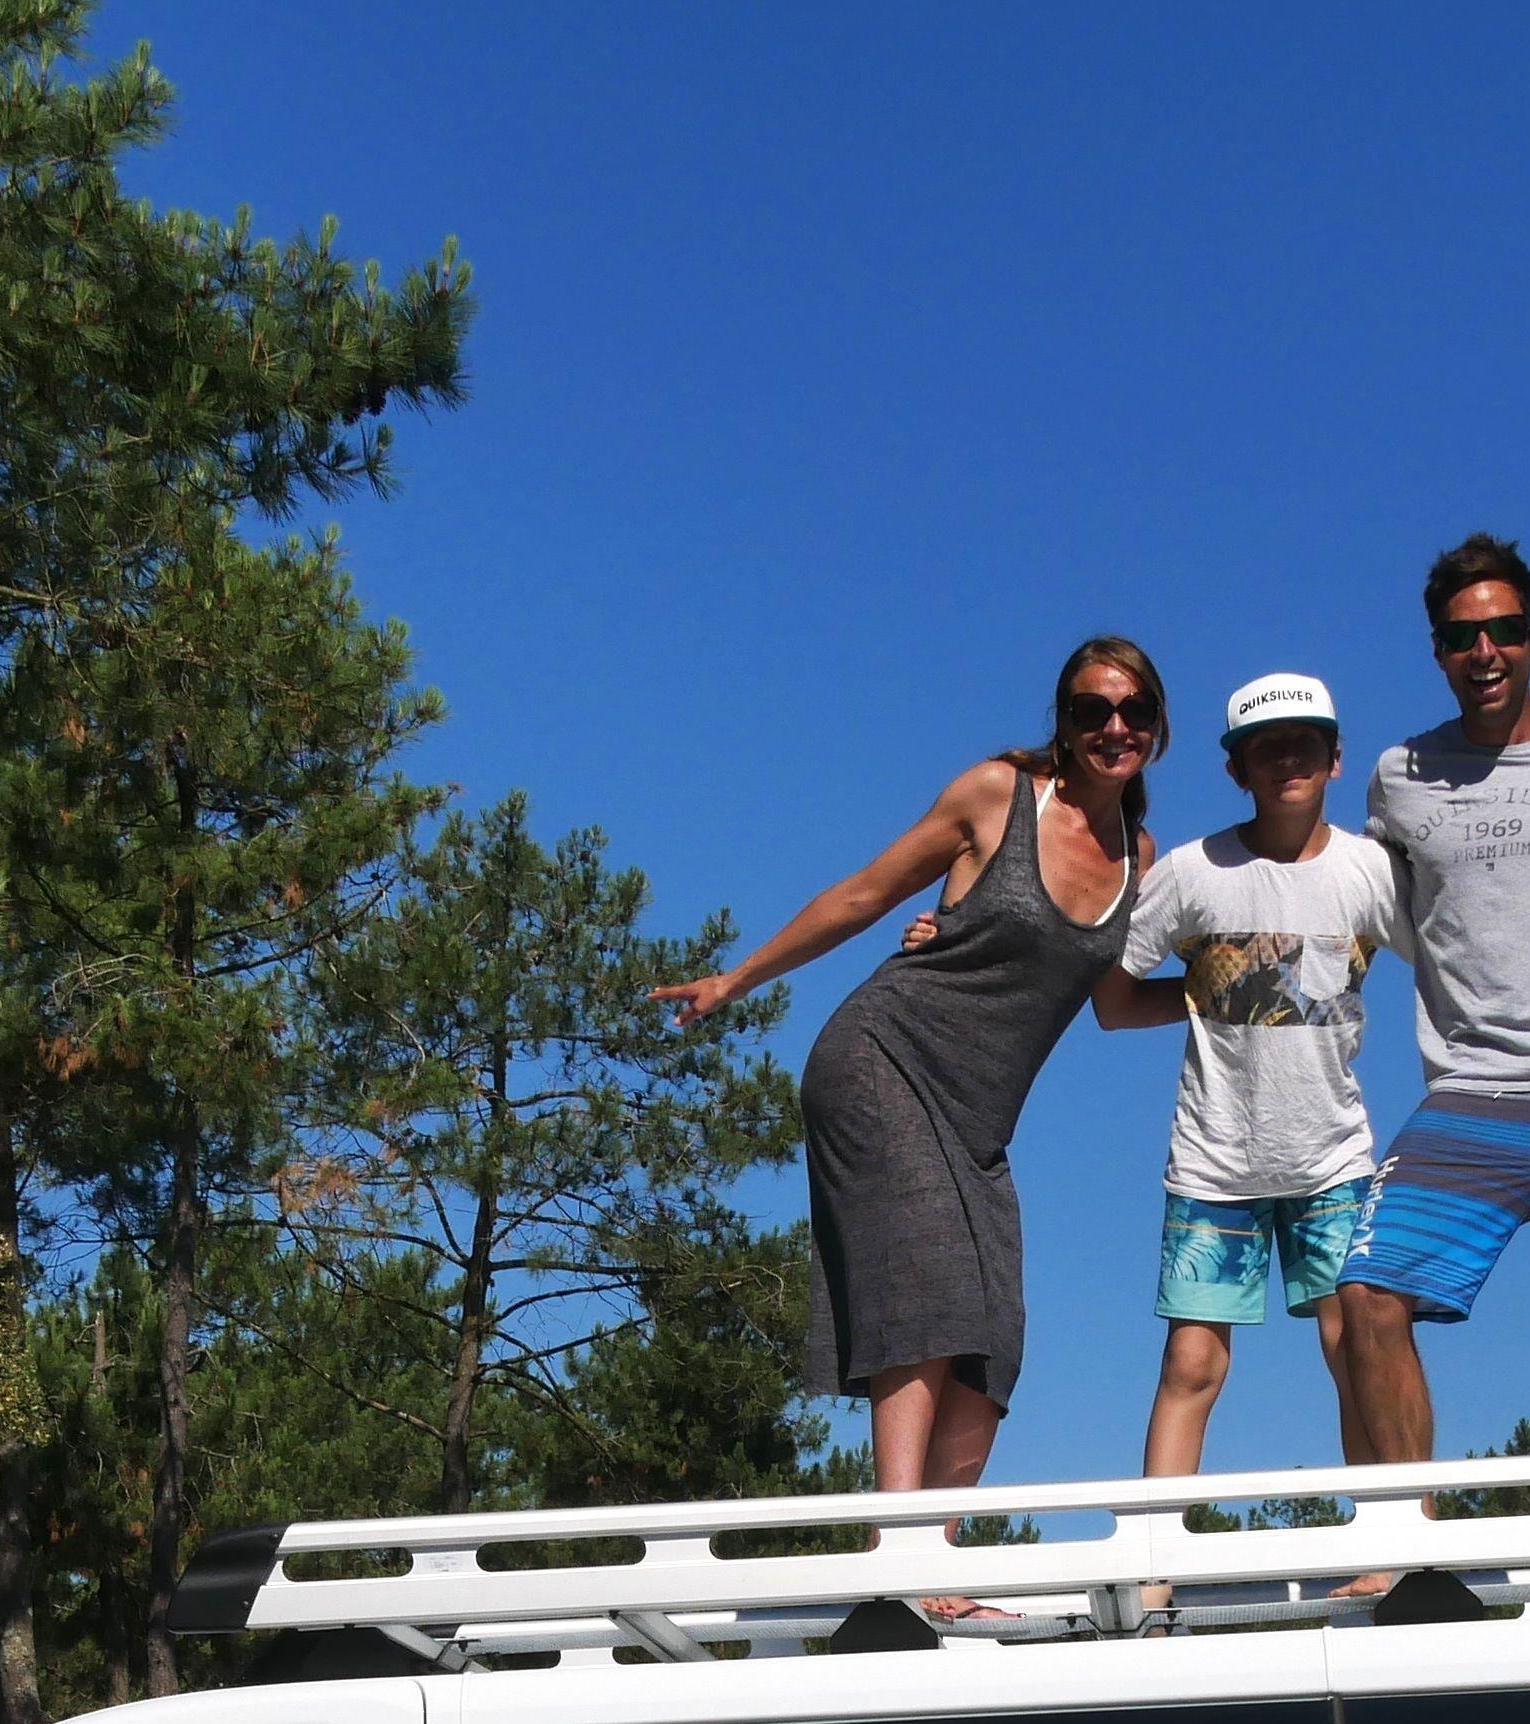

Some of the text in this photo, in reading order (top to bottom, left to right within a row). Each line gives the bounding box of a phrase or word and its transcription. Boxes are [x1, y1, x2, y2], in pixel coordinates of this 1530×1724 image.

[1239, 689, 1313, 715] QUIKSILVER
[1463, 818, 1523, 842] 1969
[1356, 1155, 1400, 1232] Hurley
